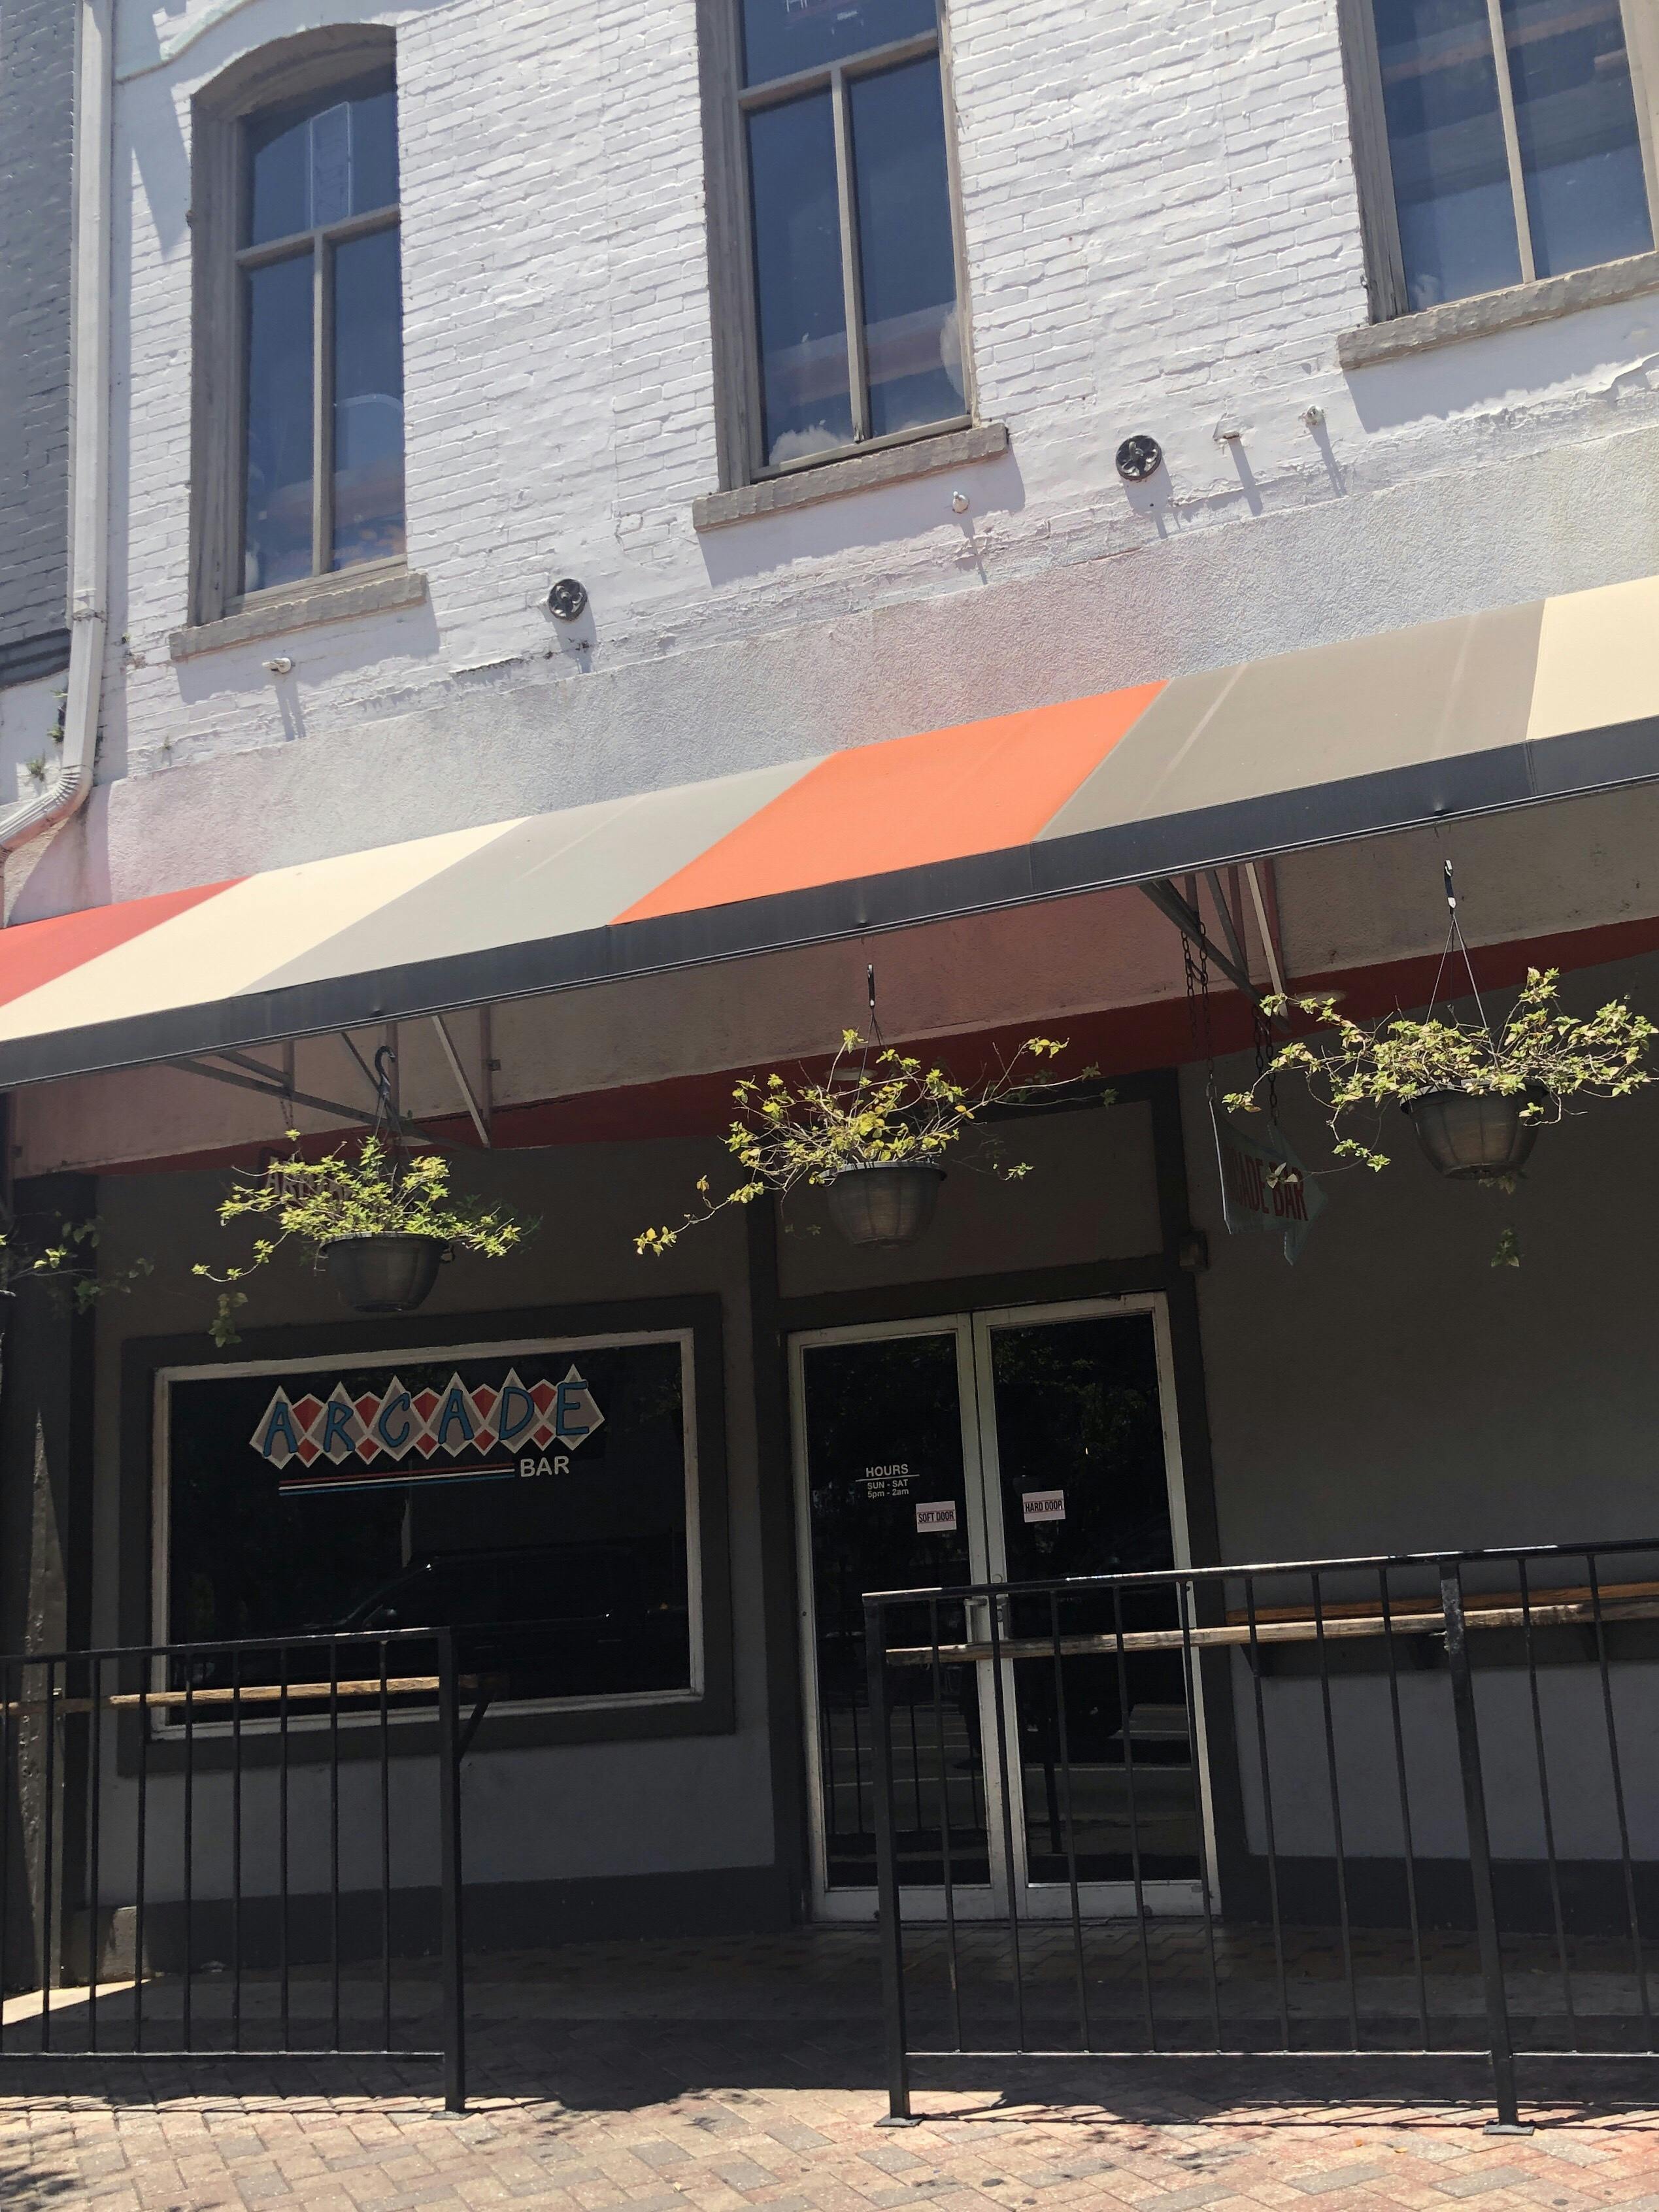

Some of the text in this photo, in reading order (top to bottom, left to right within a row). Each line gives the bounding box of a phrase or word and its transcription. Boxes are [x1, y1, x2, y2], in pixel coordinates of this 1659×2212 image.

[263, 1379, 590, 1459] ARCADE
[520, 1455, 570, 1477] BAR
[865, 1464, 909, 1477] HOURS
[867, 1481, 885, 1490] SUN
[892, 1479, 909, 1488] SAT
[867, 1490, 885, 1499] 5pm
[1024, 1500, 1063, 1513] HARD DOOR
[918, 1511, 954, 1522] SOFT DOOR
